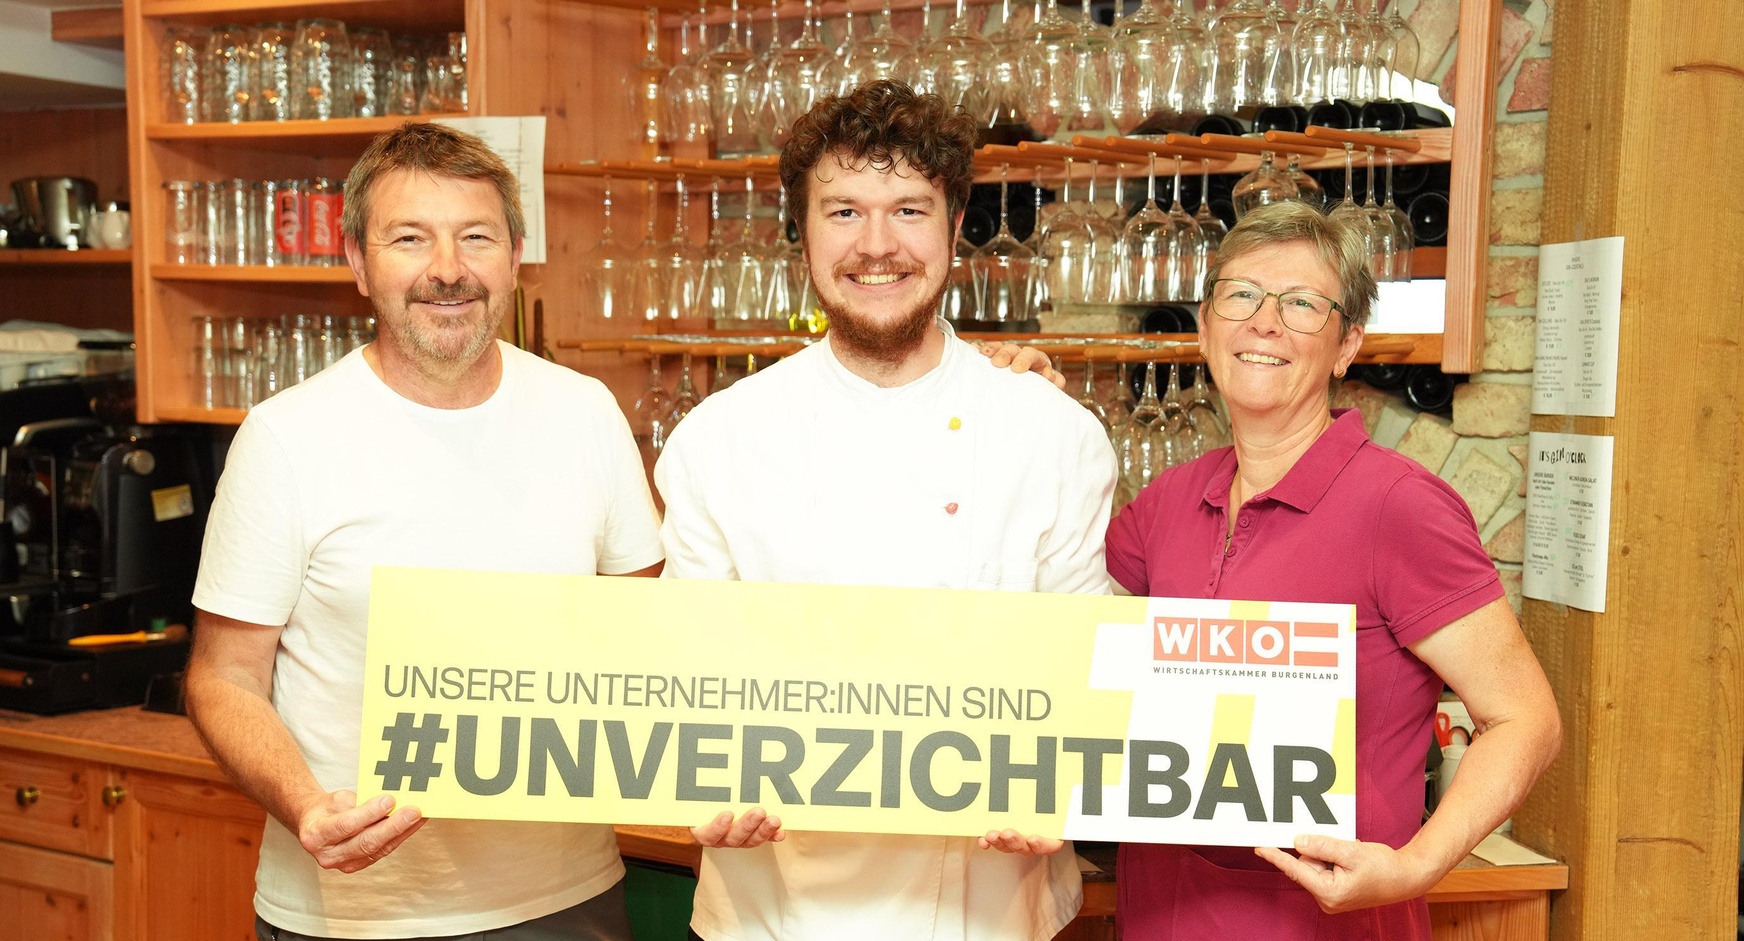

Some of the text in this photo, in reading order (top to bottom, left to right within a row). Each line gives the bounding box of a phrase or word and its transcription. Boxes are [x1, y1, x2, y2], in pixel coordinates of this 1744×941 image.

[1156, 622, 1285, 659] WKO
[384, 664, 1052, 721] UNSERE UNTERNEHMER:INNEN SIND
[1153, 666, 1340, 681] WIRTSCHAFTSKAMMER BURGENLAND
[373, 711, 1339, 826] #UNVERZICHTBAR
